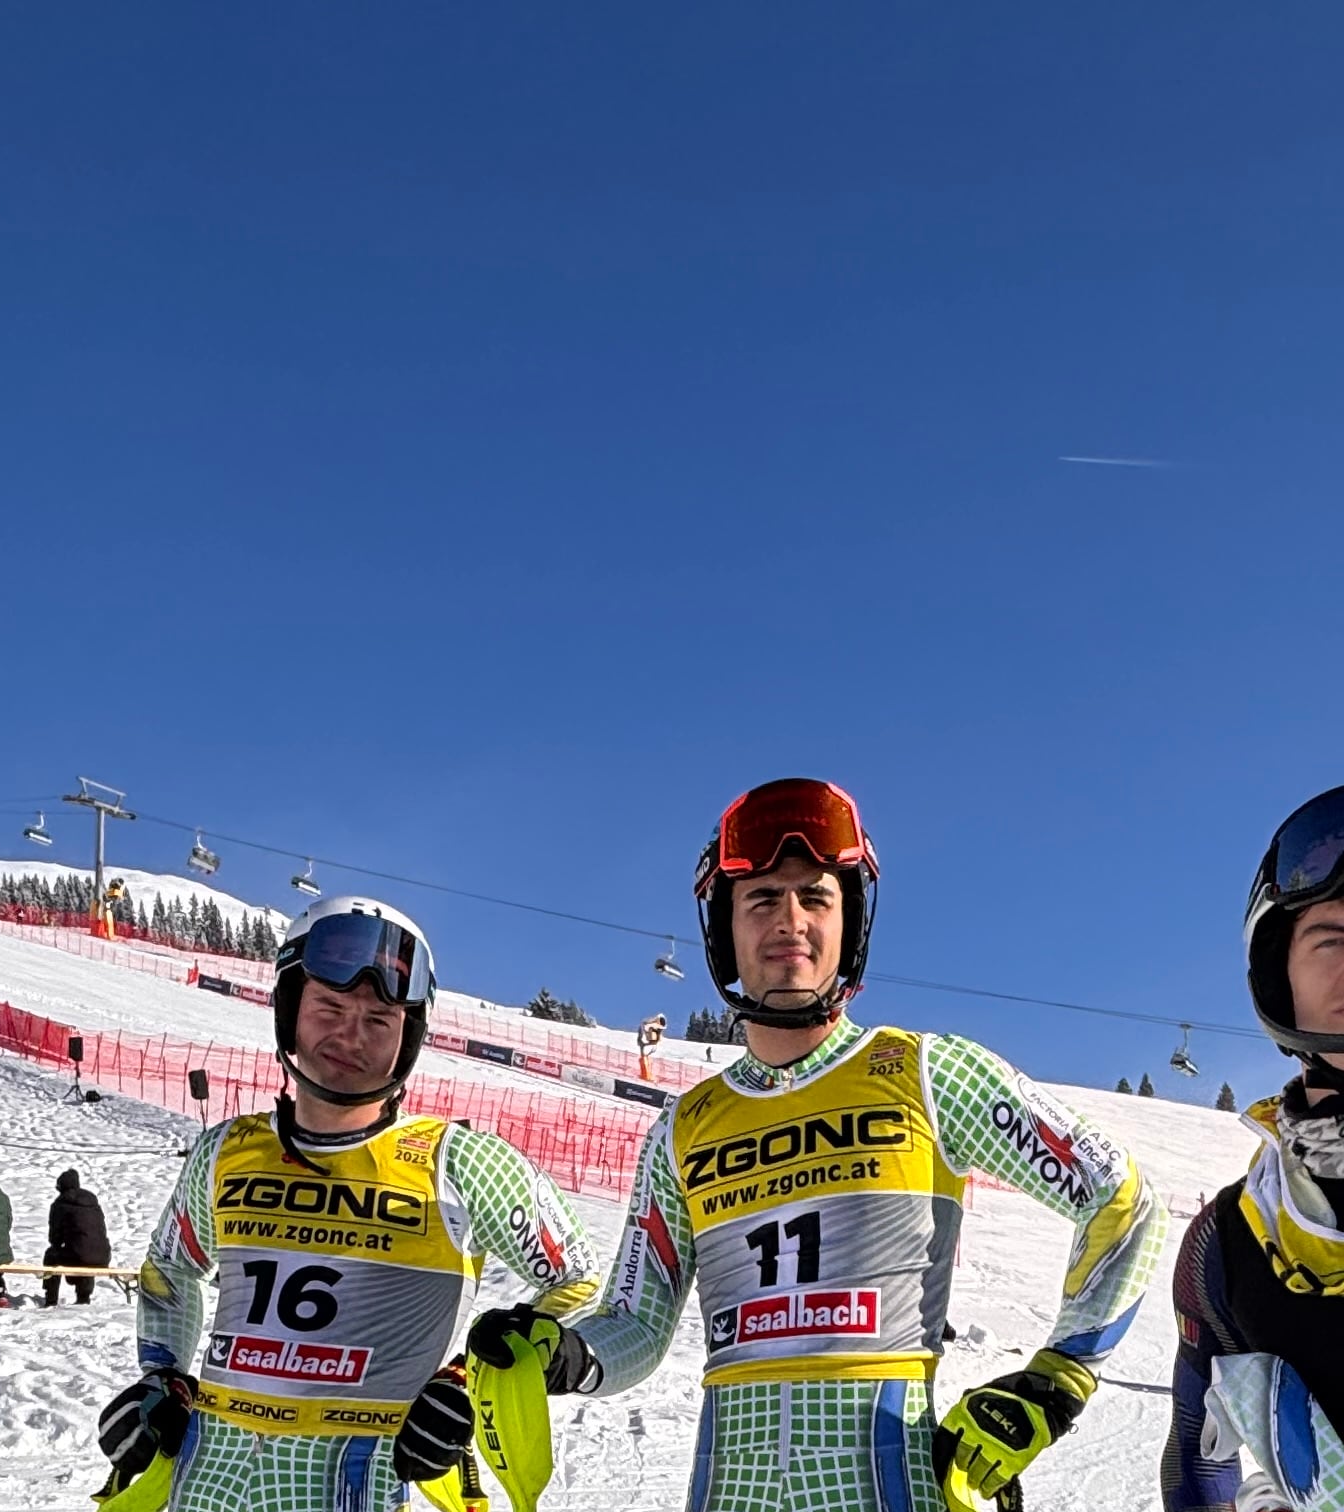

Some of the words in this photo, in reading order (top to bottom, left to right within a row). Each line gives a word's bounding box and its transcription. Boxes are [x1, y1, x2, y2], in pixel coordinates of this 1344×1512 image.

[868, 1061, 904, 1076] 2025
[395, 1150, 427, 1165] 2025
[686, 1111, 906, 1190] ZGONC
[217, 1177, 422, 1227] ZGONC
[703, 1158, 880, 1215] www.zgonc.at
[224, 1220, 393, 1251] www.zgonc.at
[745, 1211, 820, 1288] 11
[621, 1230, 643, 1298] Andorra
[243, 1260, 343, 1332] 16
[744, 1292, 868, 1335] saalbach
[235, 1340, 356, 1377] saalbach
[197, 1391, 218, 1408] ONC
[229, 1399, 297, 1421] ZGONC
[324, 1409, 402, 1425] ZGONC
[980, 1401, 1017, 1434] LEKI
[481, 1400, 507, 1471] LEKI
